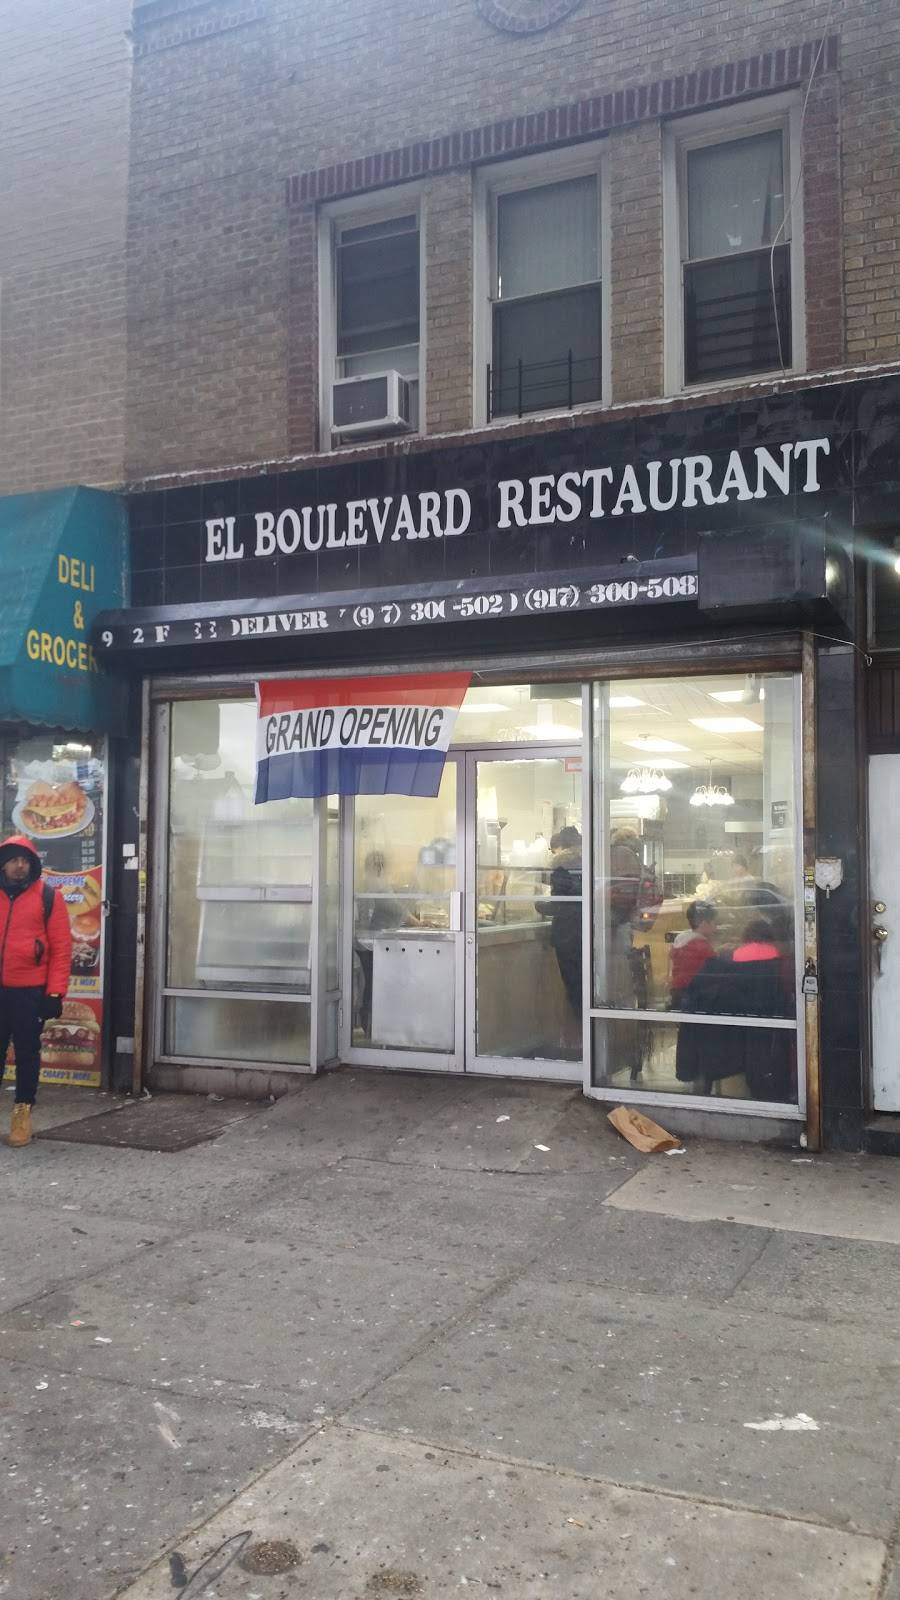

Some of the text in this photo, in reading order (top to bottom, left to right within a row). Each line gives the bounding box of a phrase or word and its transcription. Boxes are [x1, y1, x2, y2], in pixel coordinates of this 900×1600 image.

[205, 437, 832, 563] EL BOULEVARD RESTAURANT
[57, 553, 95, 594] DELI
[524, 584, 580, 610] (917)
[589, 574, 699, 604] 300-508
[73, 600, 84, 630] &
[265, 707, 444, 755] GRAND OPENING
